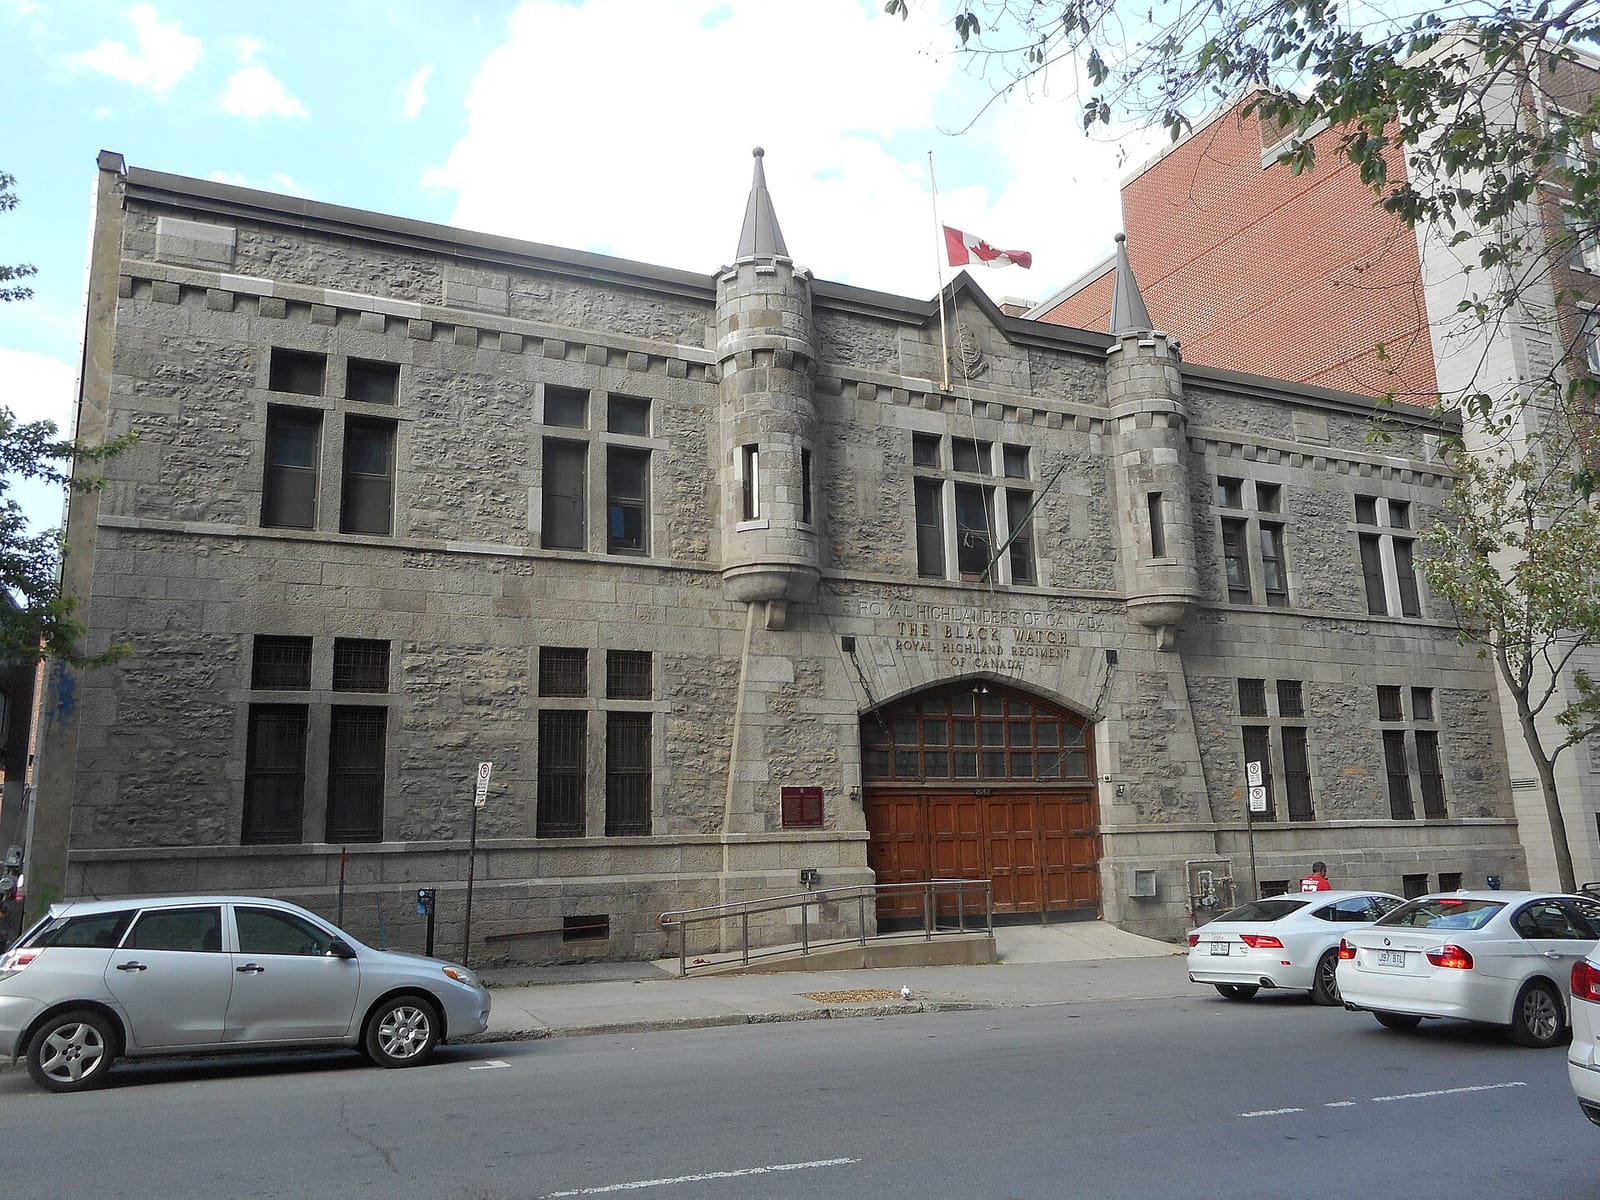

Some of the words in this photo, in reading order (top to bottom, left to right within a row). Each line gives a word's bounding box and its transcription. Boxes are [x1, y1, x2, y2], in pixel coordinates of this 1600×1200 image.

[859, 601, 913, 618] ROYAL
[916, 605, 1018, 625] HIGHLANDERS
[1023, 611, 1041, 625] OF
[1046, 613, 1105, 631] CANADA
[897, 622, 929, 637] THE
[944, 625, 999, 641] BLACK
[1014, 628, 1067, 645] WATCH
[895, 640, 934, 652] ROYAL
[942, 642, 1004, 656] HIGHLAND
[1011, 646, 1071, 659] REGIMENT
[950, 656, 966, 667] OF
[974, 657, 1022, 670] CANADA
